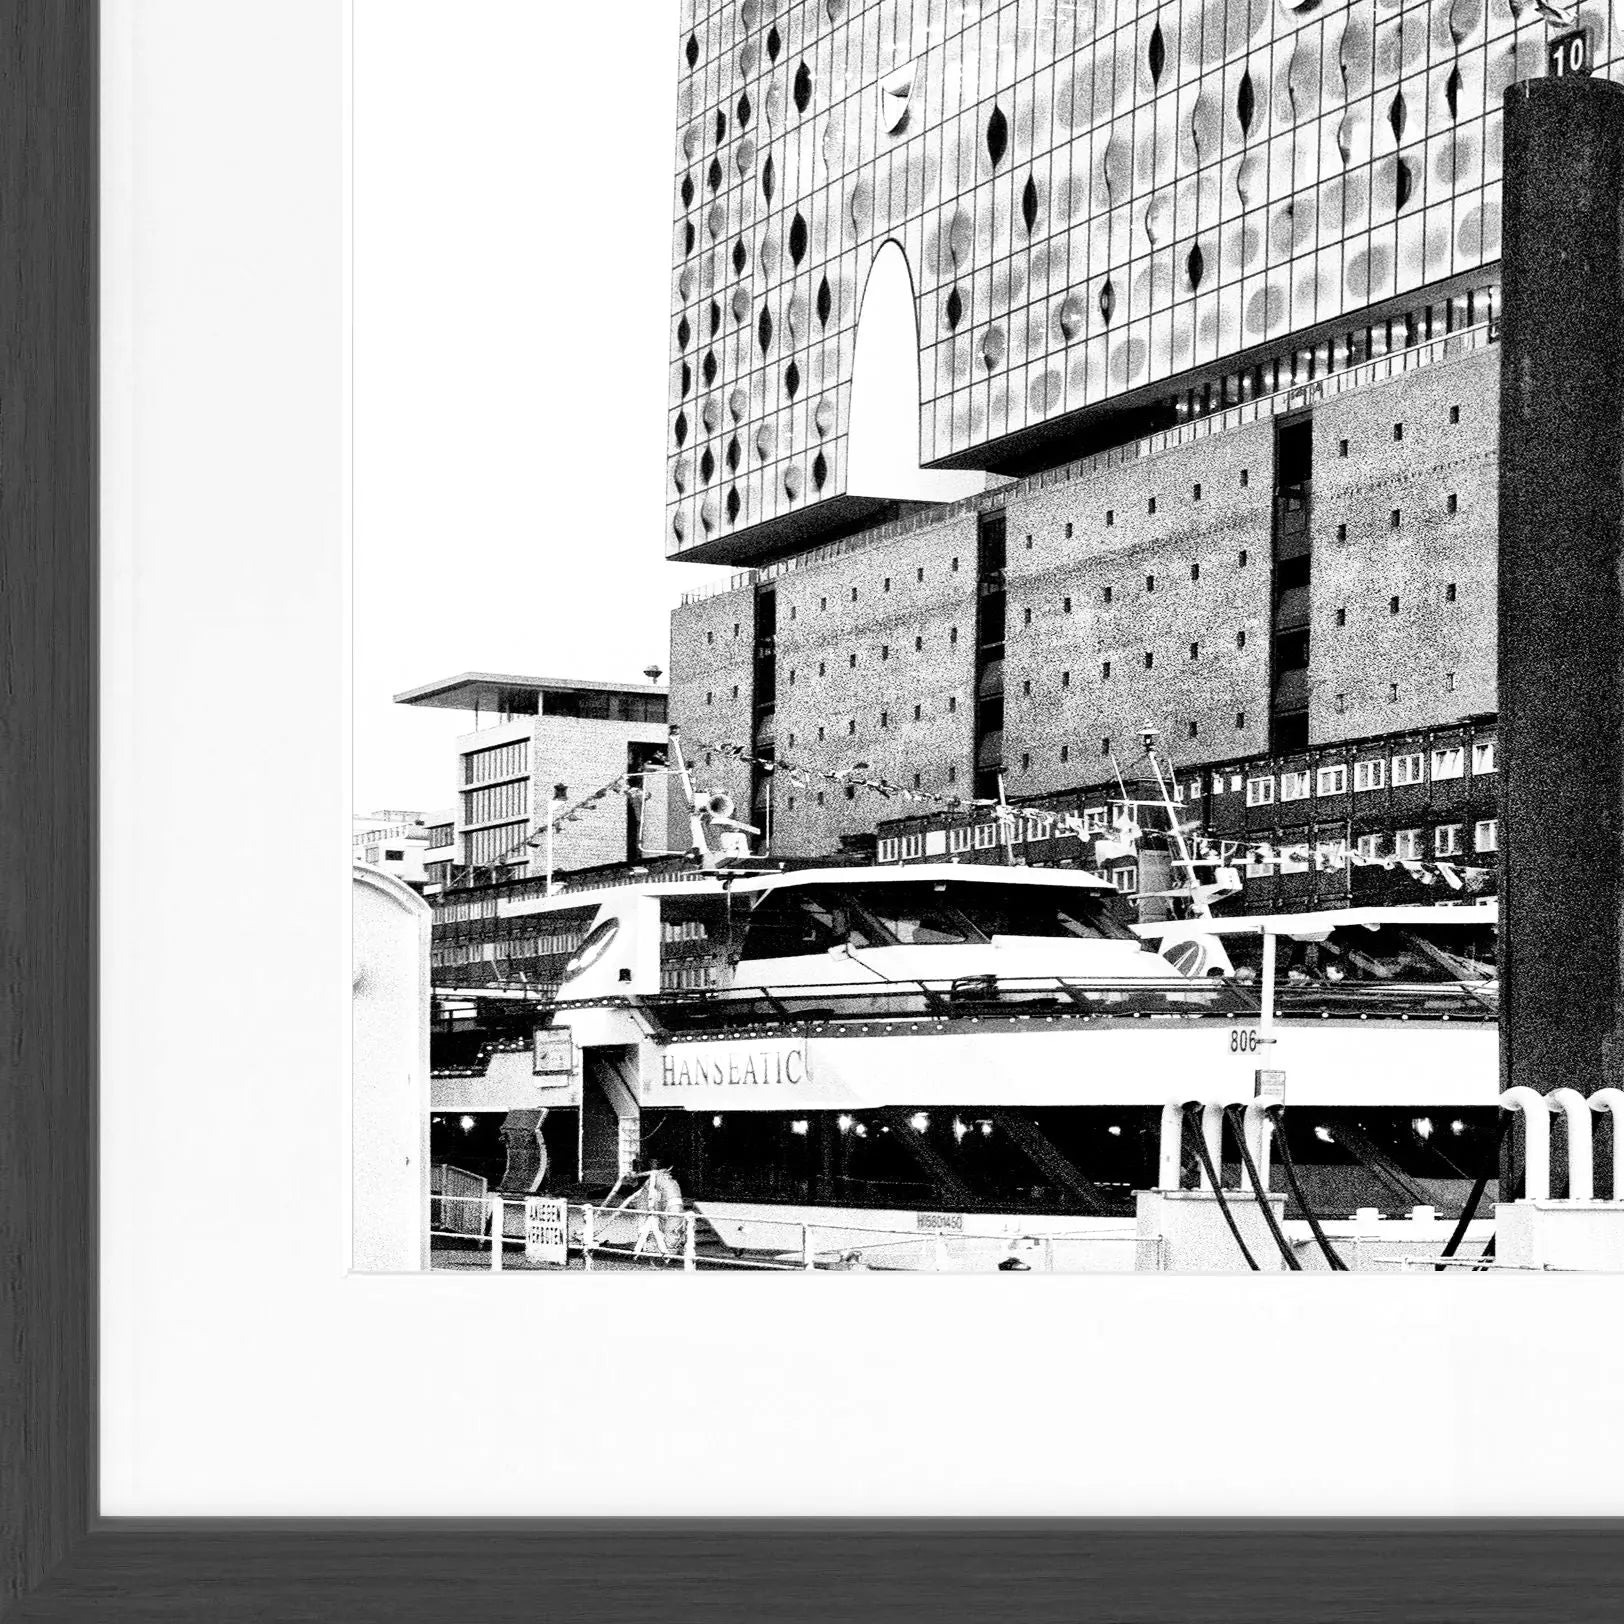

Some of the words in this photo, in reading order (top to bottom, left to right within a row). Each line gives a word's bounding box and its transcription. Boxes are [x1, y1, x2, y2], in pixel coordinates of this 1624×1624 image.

[1552, 37, 1585, 77] 10
[1230, 1029, 1257, 1053] 806
[661, 1049, 802, 1087] HANSEATIC
